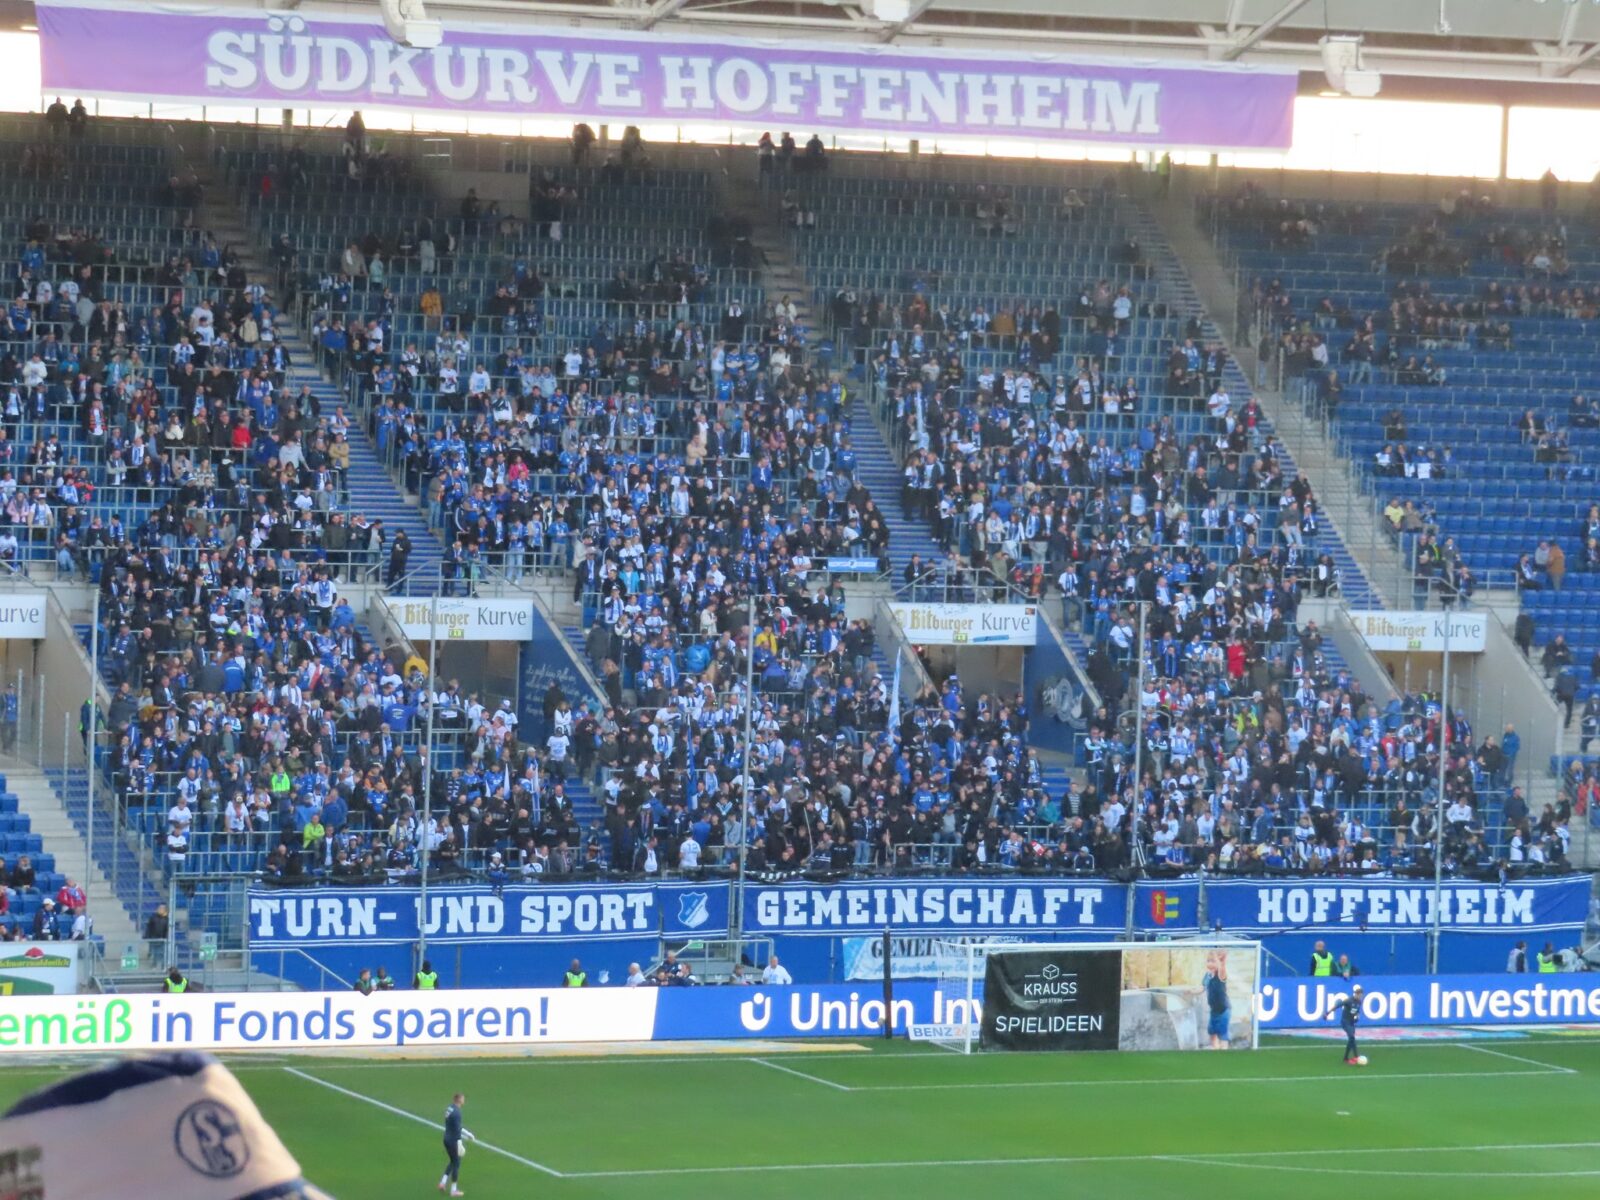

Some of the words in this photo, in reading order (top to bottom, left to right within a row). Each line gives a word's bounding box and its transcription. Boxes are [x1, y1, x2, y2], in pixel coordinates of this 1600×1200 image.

[206, 17, 643, 108] SÜDKURVE
[660, 56, 1161, 134] HOFFENHEIM
[477, 606, 527, 626] Kurve
[910, 607, 974, 633] Bitburger
[981, 612, 1031, 631] Kurve
[1365, 616, 1427, 639] Bitburger
[250, 898, 397, 937] TURN-
[414, 896, 504, 934] UND
[521, 892, 653, 933] SPORT
[756, 888, 1102, 926] GEMEINSCHAFT
[1257, 888, 1535, 924] HOFFENHEIM
[1024, 982, 1077, 996] KRAUSS
[1297, 984, 1412, 1021] Unon
[151, 1000, 193, 1042] in
[213, 997, 356, 1042] Fonds
[372, 996, 549, 1046] sparen!
[790, 992, 914, 1030] Union
[995, 1014, 1103, 1034] SPIELIDEEN
